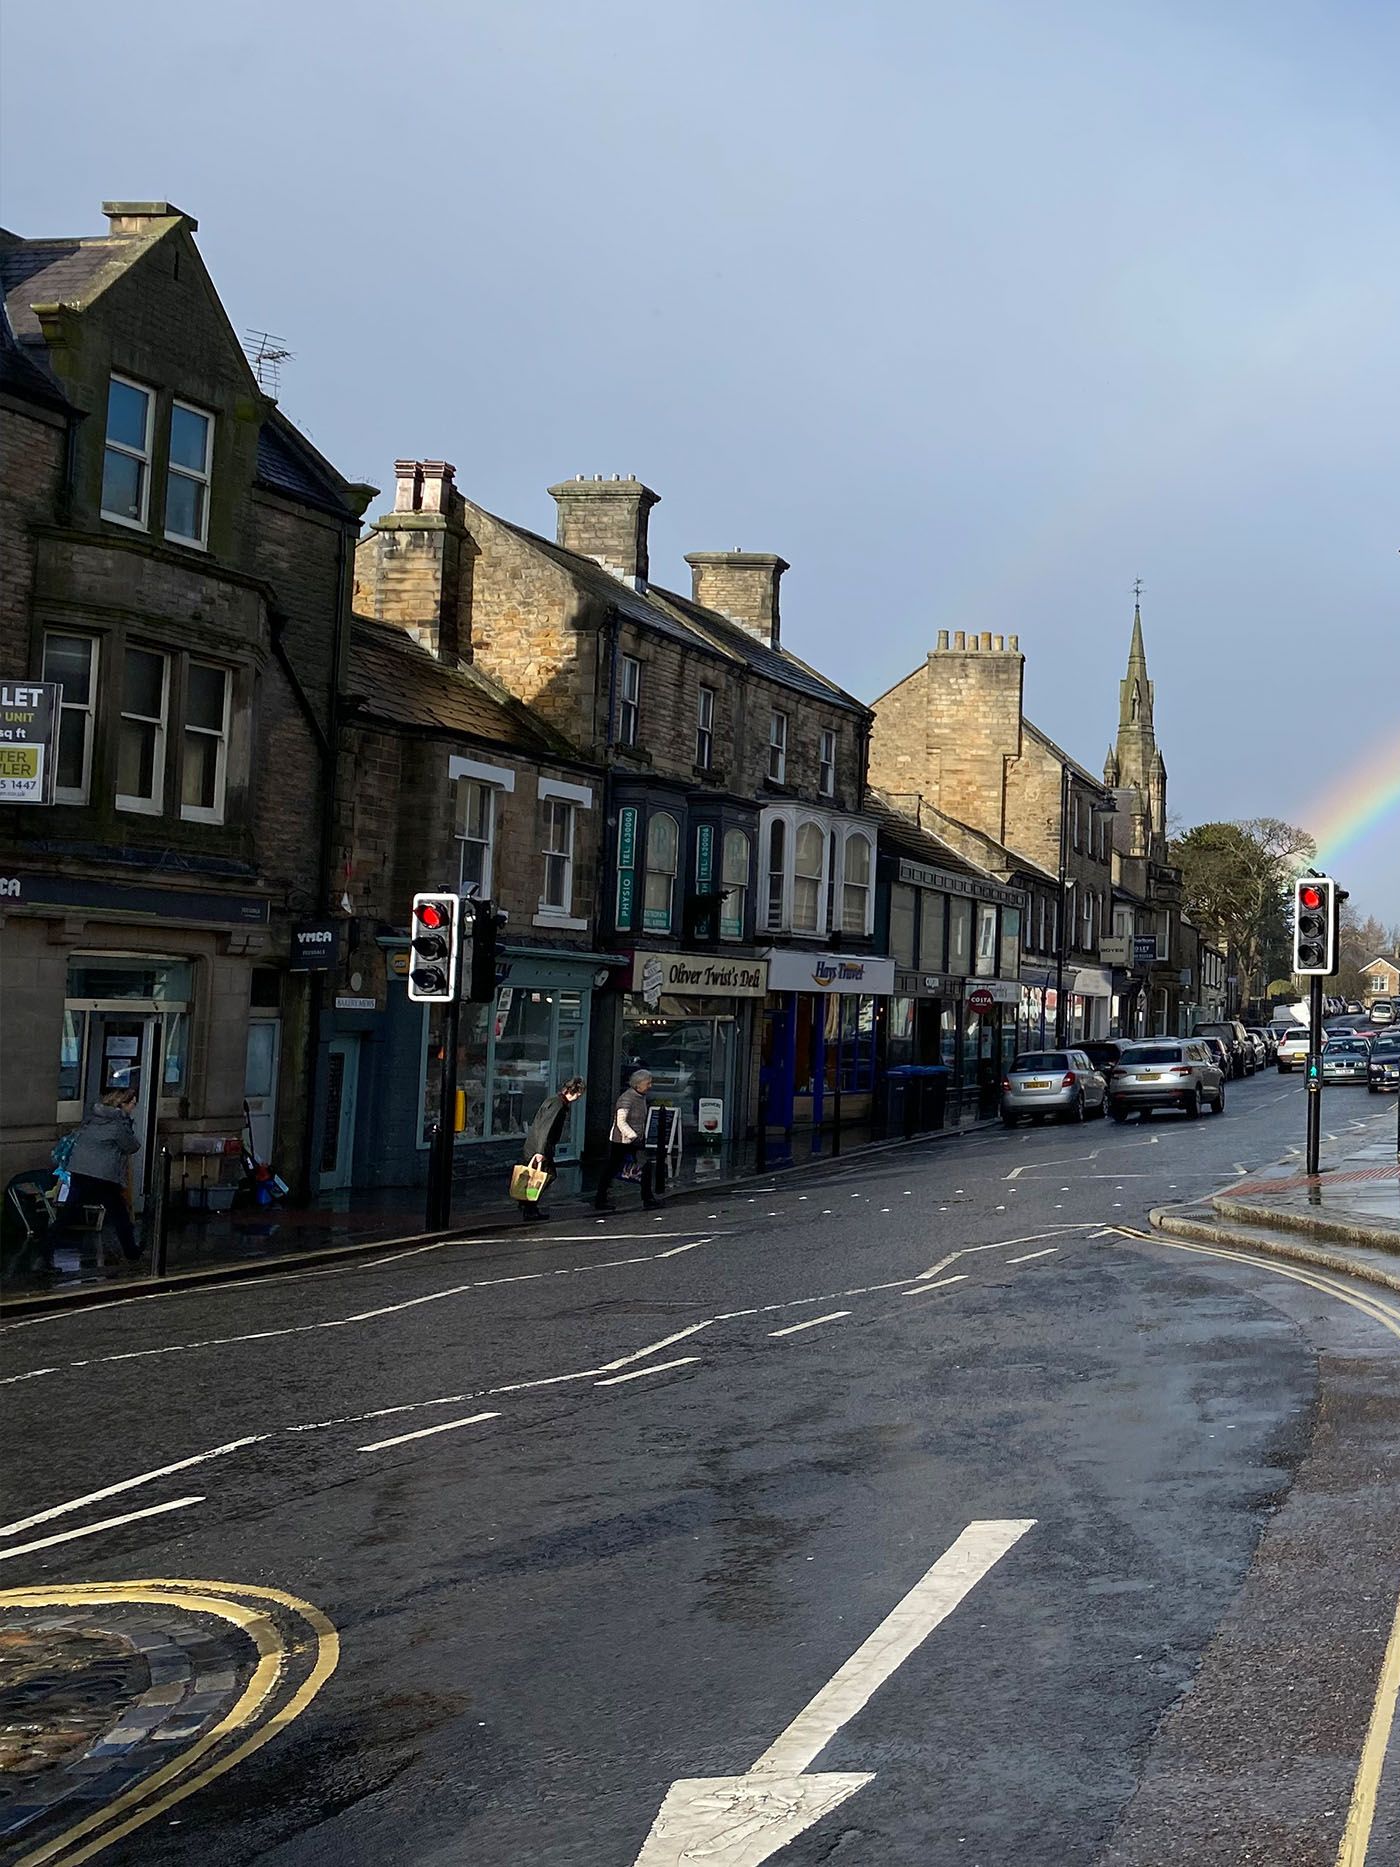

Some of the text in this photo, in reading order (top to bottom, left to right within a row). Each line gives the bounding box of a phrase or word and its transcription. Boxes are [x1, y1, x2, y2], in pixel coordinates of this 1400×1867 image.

[1, 686, 43, 707] LET
[5, 712, 34, 723] UNIT
[16, 727, 26, 739] ft
[11, 780, 36, 790] 1447
[623, 811, 632, 843] 630006
[621, 878, 631, 917] PHYSIO
[297, 930, 332, 943] YMCA
[669, 962, 703, 984] Oliver
[704, 964, 738, 986] Twist's
[740, 968, 761, 988] Deli
[815, 960, 865, 982] Hays Travel
